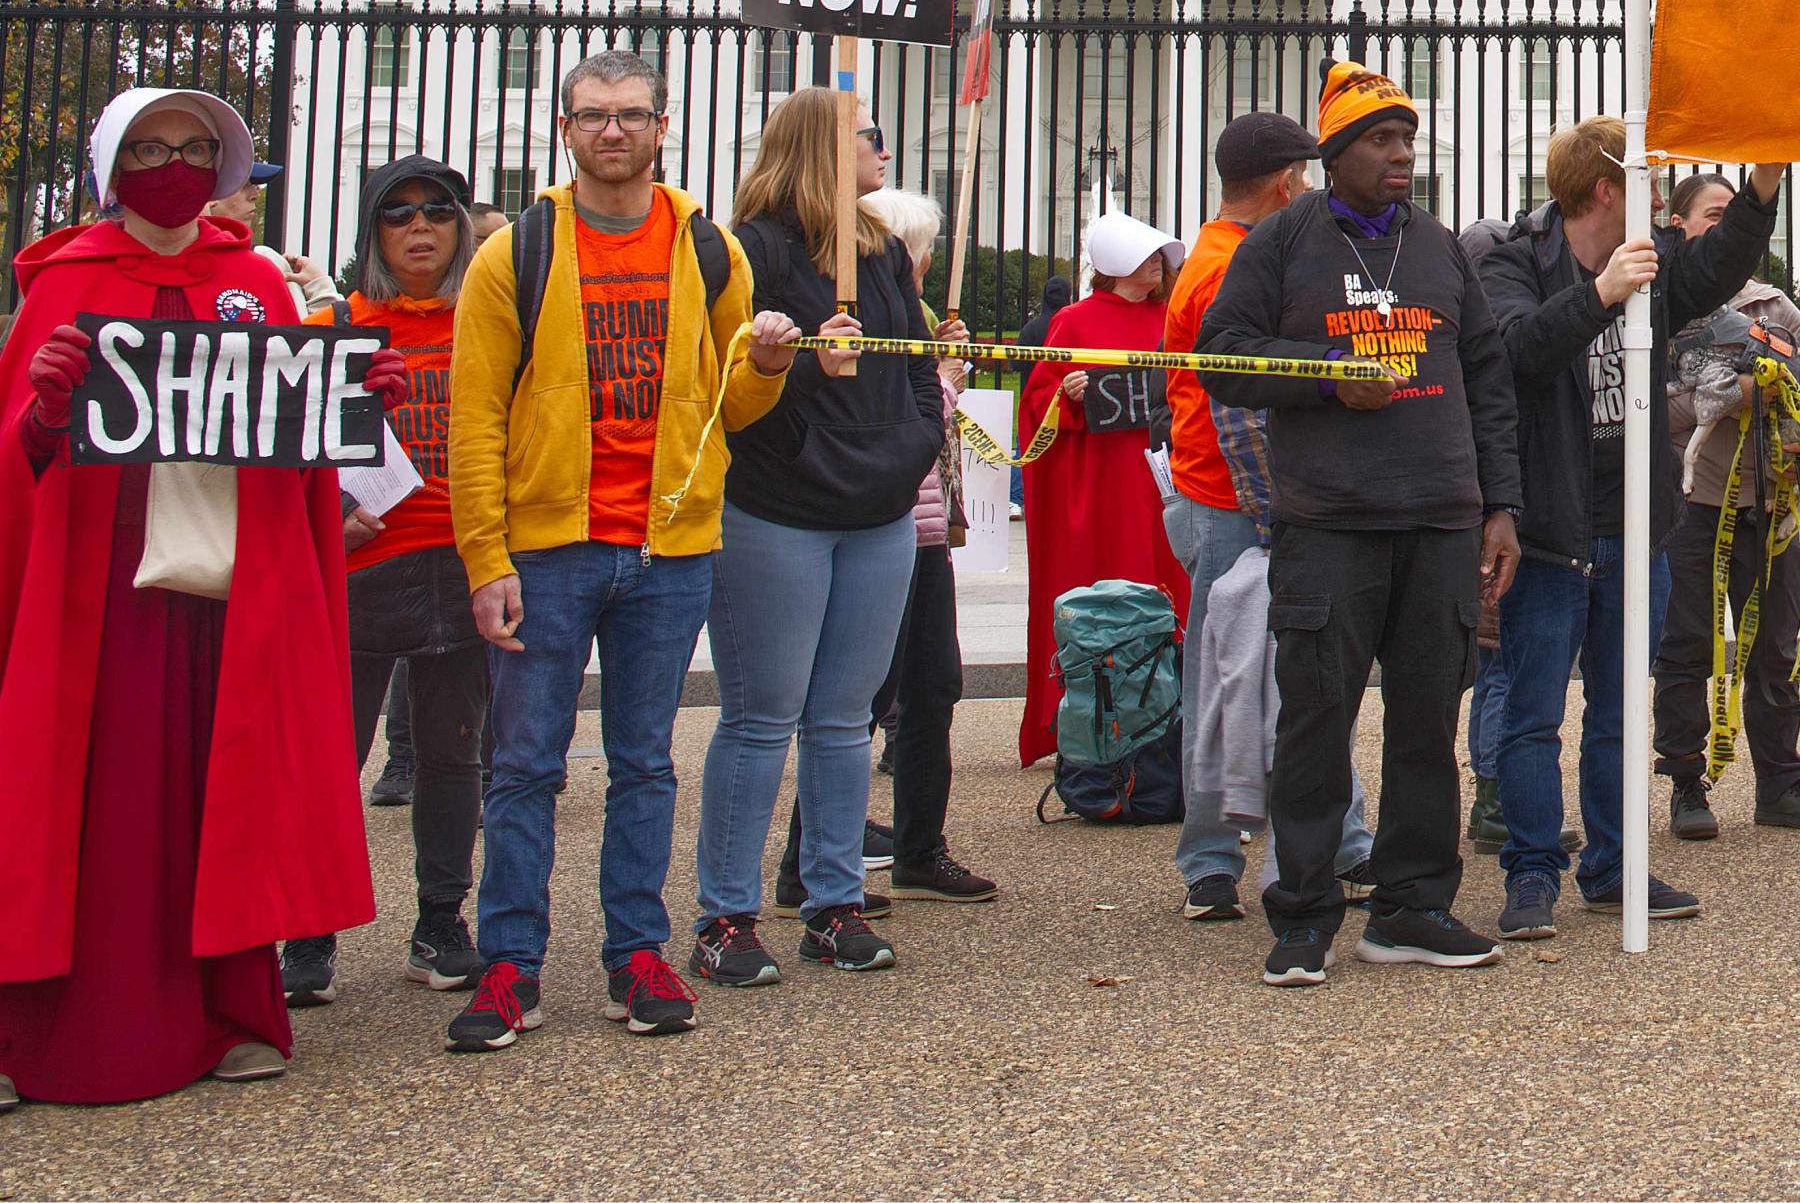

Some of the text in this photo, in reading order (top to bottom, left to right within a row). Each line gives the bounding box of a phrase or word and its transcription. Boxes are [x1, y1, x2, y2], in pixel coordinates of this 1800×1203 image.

[1343, 273, 1362, 290] BA
[586, 297, 669, 341] RUM
[1350, 330, 1428, 357] NOTHING
[1370, 354, 1418, 378] ESS!
[87, 321, 381, 461] SHAME
[404, 369, 451, 405] UM
[613, 378, 663, 420] NO
[1099, 372, 1150, 426] SH
[1390, 384, 1445, 401] om.us
[388, 405, 450, 444] MUS
[410, 441, 450, 479] NO
